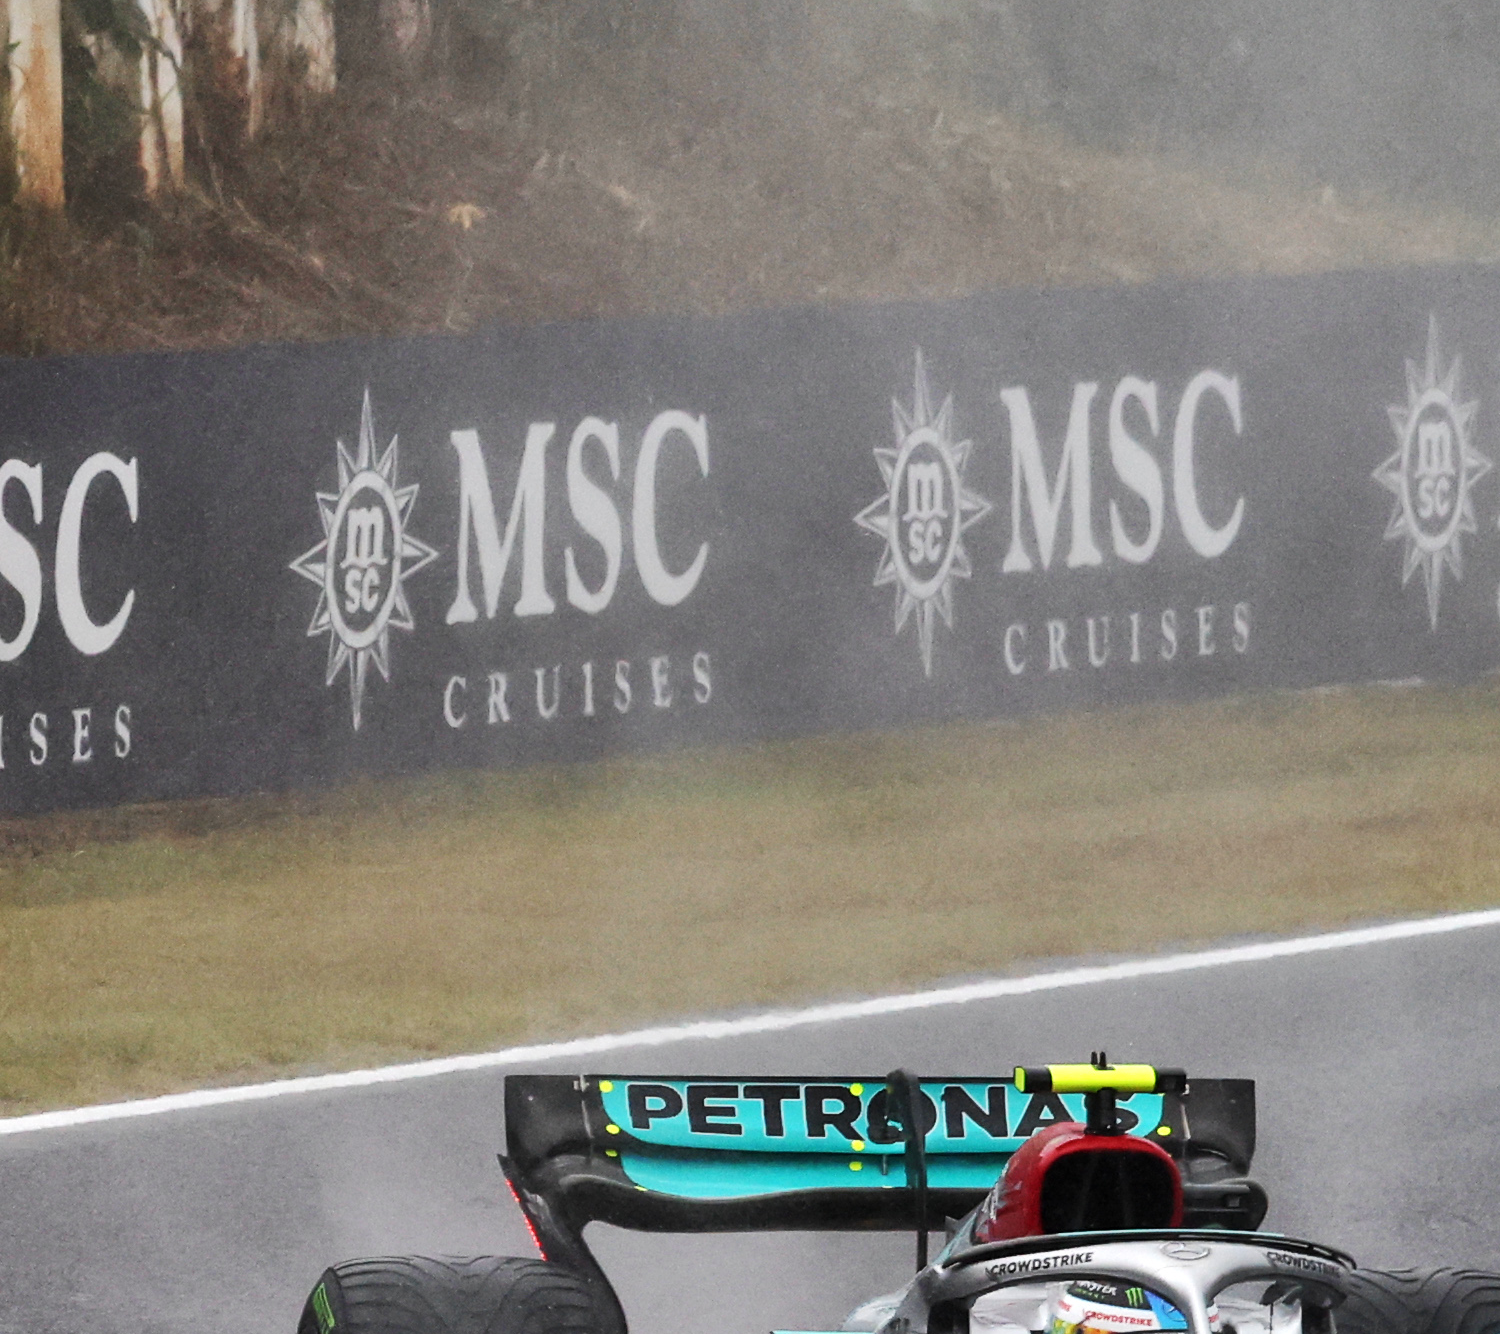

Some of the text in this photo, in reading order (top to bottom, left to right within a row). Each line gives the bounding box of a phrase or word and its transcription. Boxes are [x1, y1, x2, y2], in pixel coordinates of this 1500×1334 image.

[1000, 370, 1244, 573] MSC
[447, 410, 710, 625] MSC
[1004, 602, 1251, 675] CRUISES
[443, 652, 712, 728] CRUISES
[0, 705, 131, 766] SES
[991, 1251, 1094, 1277] CROWDSTRIKE
